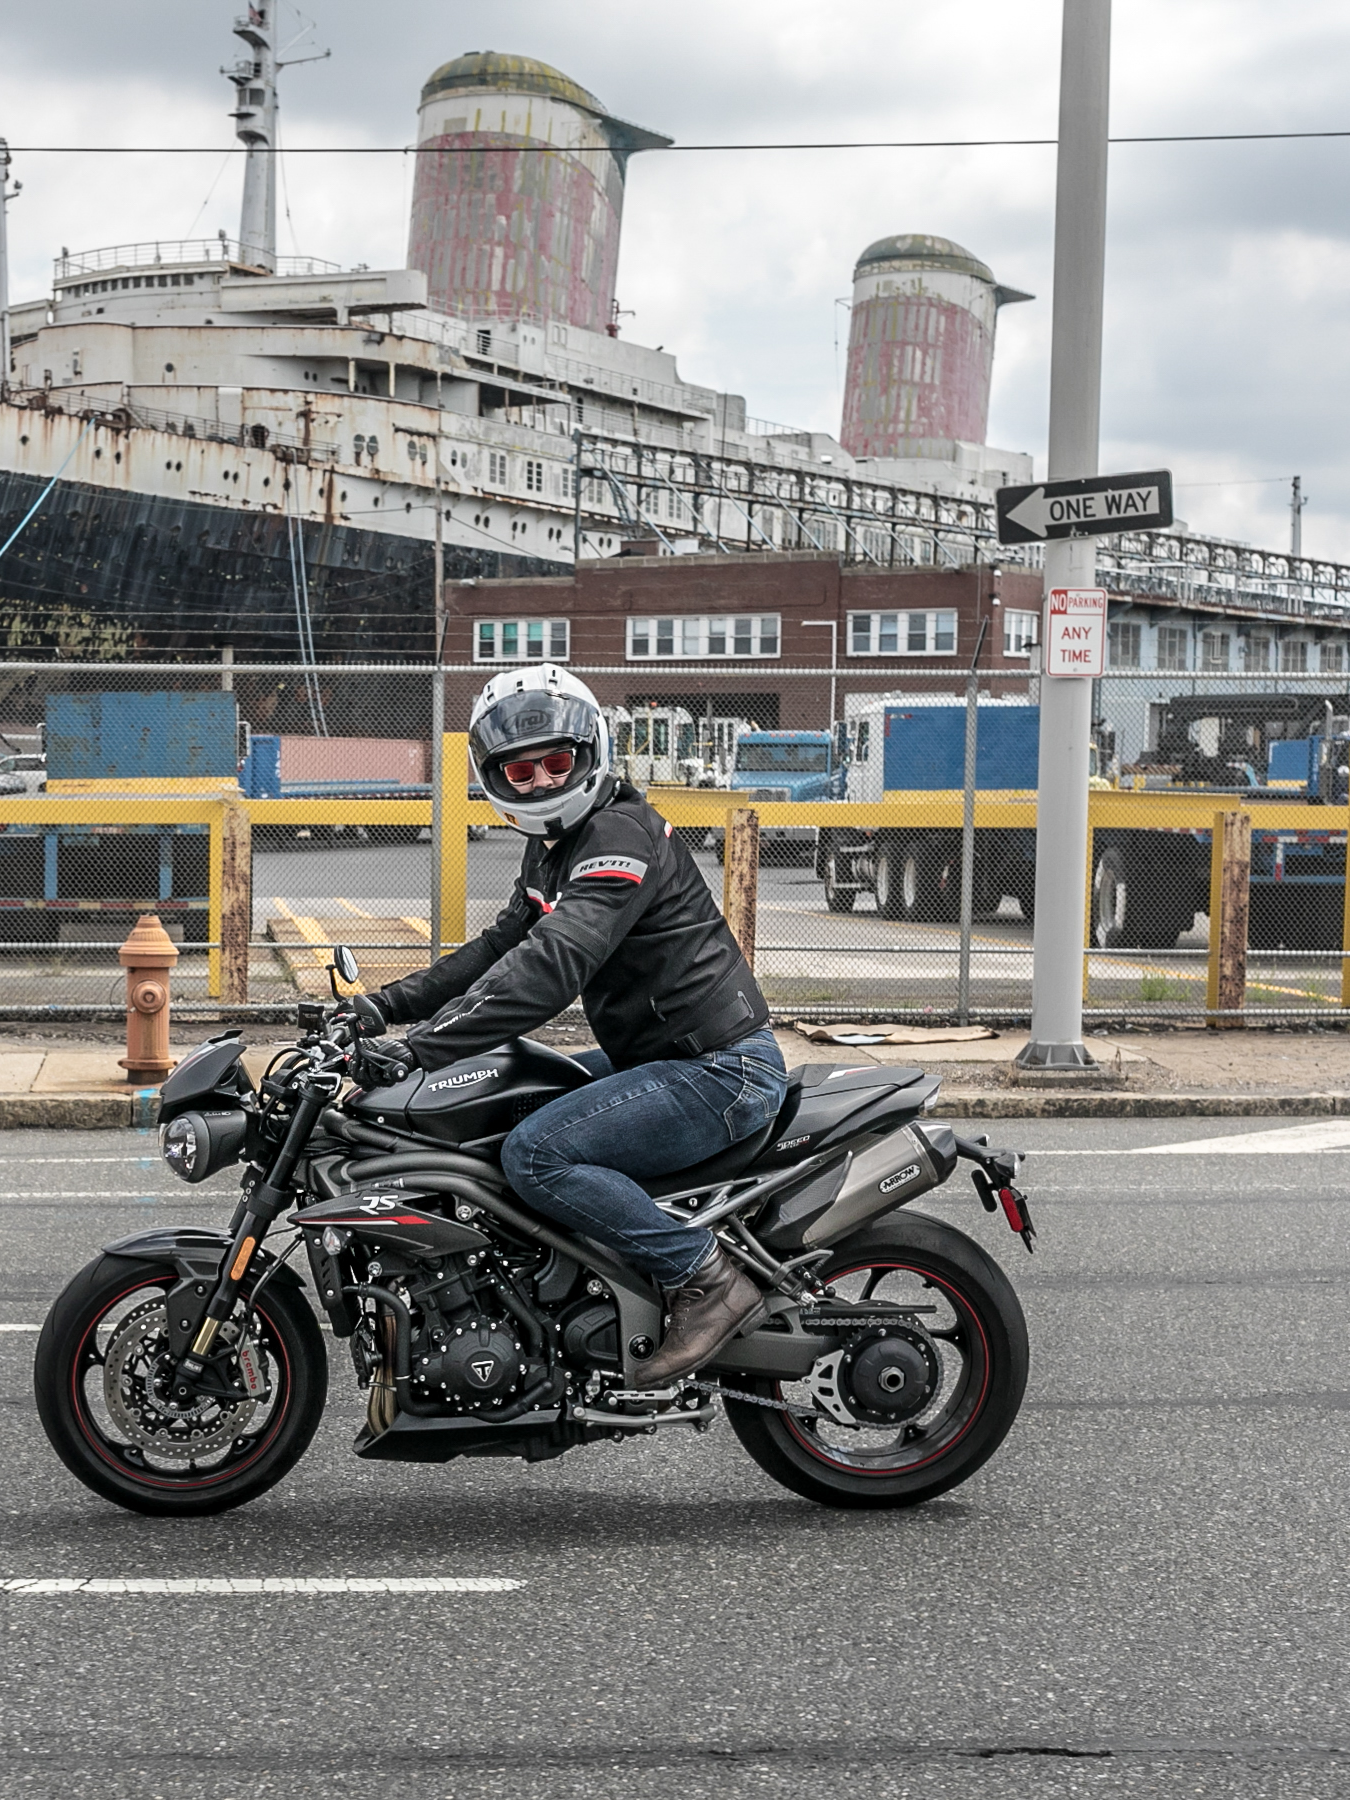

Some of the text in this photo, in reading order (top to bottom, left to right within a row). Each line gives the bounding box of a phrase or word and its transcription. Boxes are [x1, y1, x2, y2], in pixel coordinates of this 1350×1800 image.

[1050, 490, 1152, 522] ONE WAY
[1051, 593, 1103, 611] NO PARKING
[1061, 626, 1092, 640] ANY
[1060, 649, 1092, 663] TIME
[428, 1068, 499, 1092] TRIUMPH
[359, 1195, 399, 1215] RS
[242, 1350, 258, 1389] brembo
